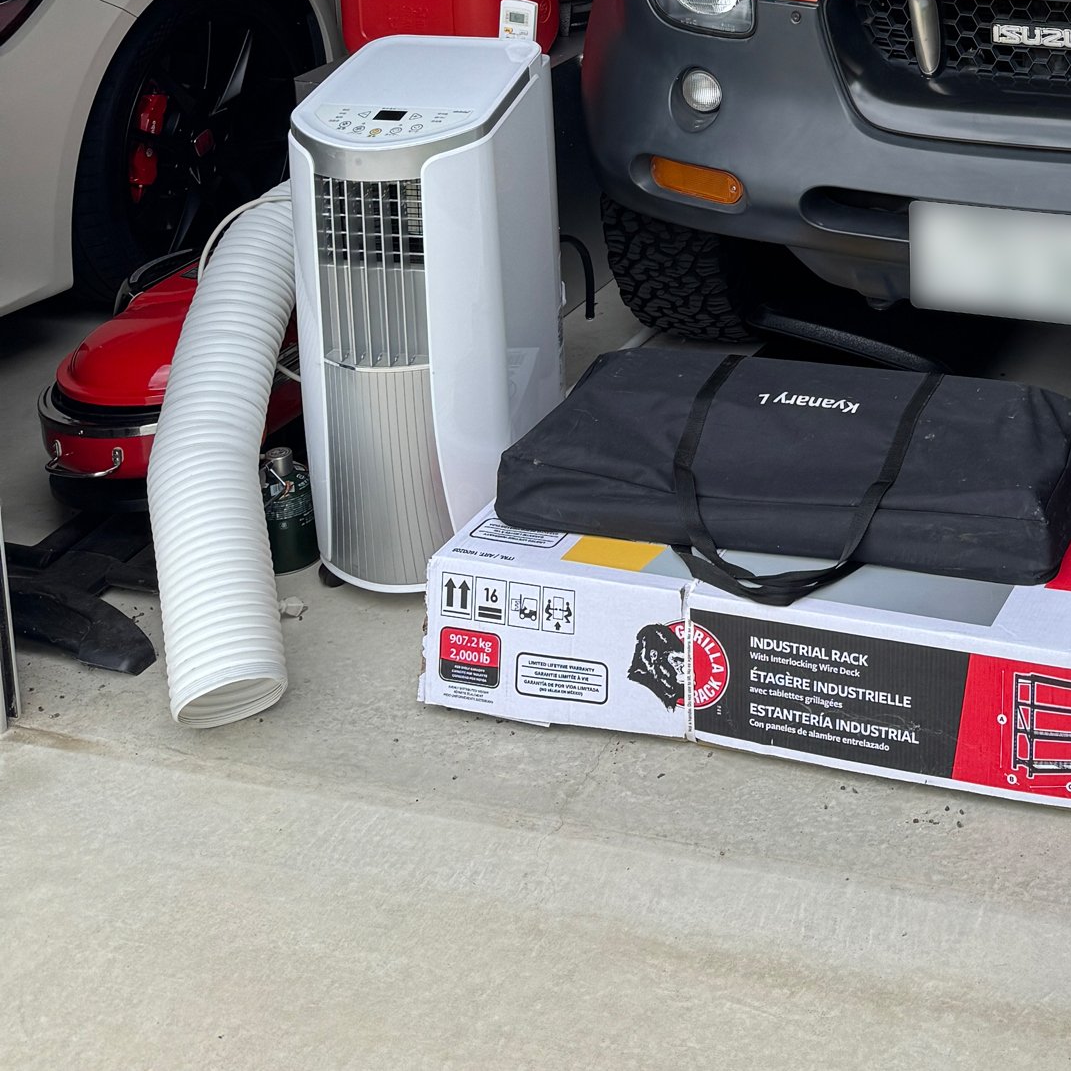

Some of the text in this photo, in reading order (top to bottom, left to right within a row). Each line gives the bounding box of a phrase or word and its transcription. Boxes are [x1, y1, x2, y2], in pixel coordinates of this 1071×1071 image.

[759, 391, 860, 413] Kyanary L
[484, 587, 498, 603] 16
[449, 633, 492, 653] 907.2 kg
[750, 635, 868, 667] INDUSTRIAL RACK
[450, 648, 490, 665] 2,000 lb
[750, 651, 860, 677] With Interlocking Wire Deck
[524, 679, 546, 687] GARANTÍA
[566, 683, 576, 691] VIDA
[578, 685, 600, 693] LIMITADA
[534, 671, 558, 679] GARANTIE
[749, 685, 844, 709] avec tablettes grillagées
[750, 666, 912, 709] ÉTAGÈRE INDUSTRIELLE
[749, 718, 890, 751] Con paneles de alambre entrelazado
[750, 703, 920, 745] ESTANTERÍA INDUSTRIAL
